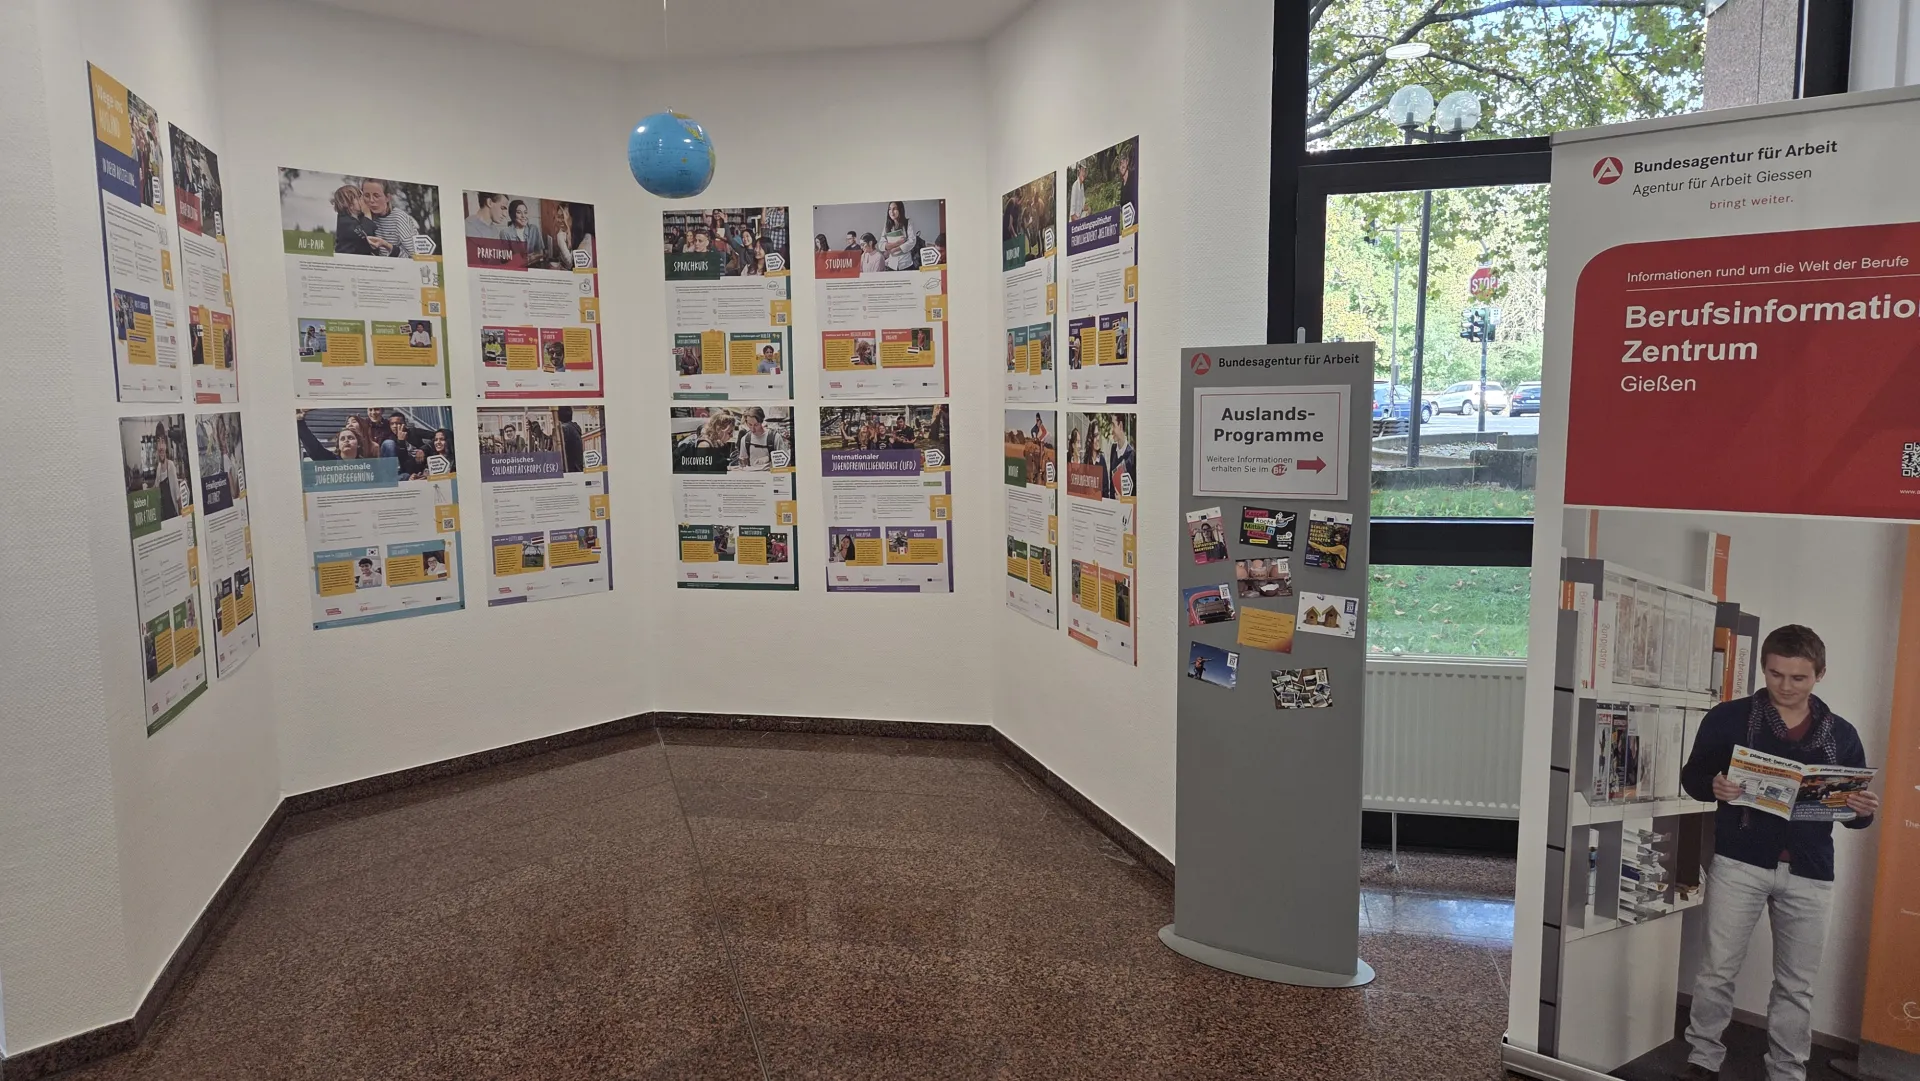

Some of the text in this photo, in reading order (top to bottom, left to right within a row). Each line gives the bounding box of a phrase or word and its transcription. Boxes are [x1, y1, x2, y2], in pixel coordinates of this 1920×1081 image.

[1633, 140, 1838, 174] Bundesagentur für Arbeit
[1632, 168, 1812, 198] Agentur für Arbeit Giessen
[1709, 194, 1794, 210] bringt weiter.
[298, 238, 324, 250] AU-PAIR
[477, 247, 512, 260] PRAKTIKUM
[674, 261, 708, 272] SPRACHKURS
[825, 258, 852, 269] STUDIUM
[1627, 256, 1909, 282] Informationen rund um die Welt der Berufe
[1472, 276, 1496, 292] STOP
[1625, 294, 1920, 328] Berufsinformatio
[1622, 339, 1758, 362] Zentrum
[1218, 354, 1359, 368] Bundesagentur für Arbeit
[1621, 376, 1696, 392] Gießen
[1221, 407, 1315, 421] Auslands-
[1214, 429, 1324, 445] Programme
[315, 462, 371, 472] Internationale
[492, 457, 534, 465] Europäisches
[543, 462, 559, 473] (ESK)
[315, 472, 374, 485] JUGENDBEGEGNUNG
[1750, 752, 1802, 771] planet-beruf.de
